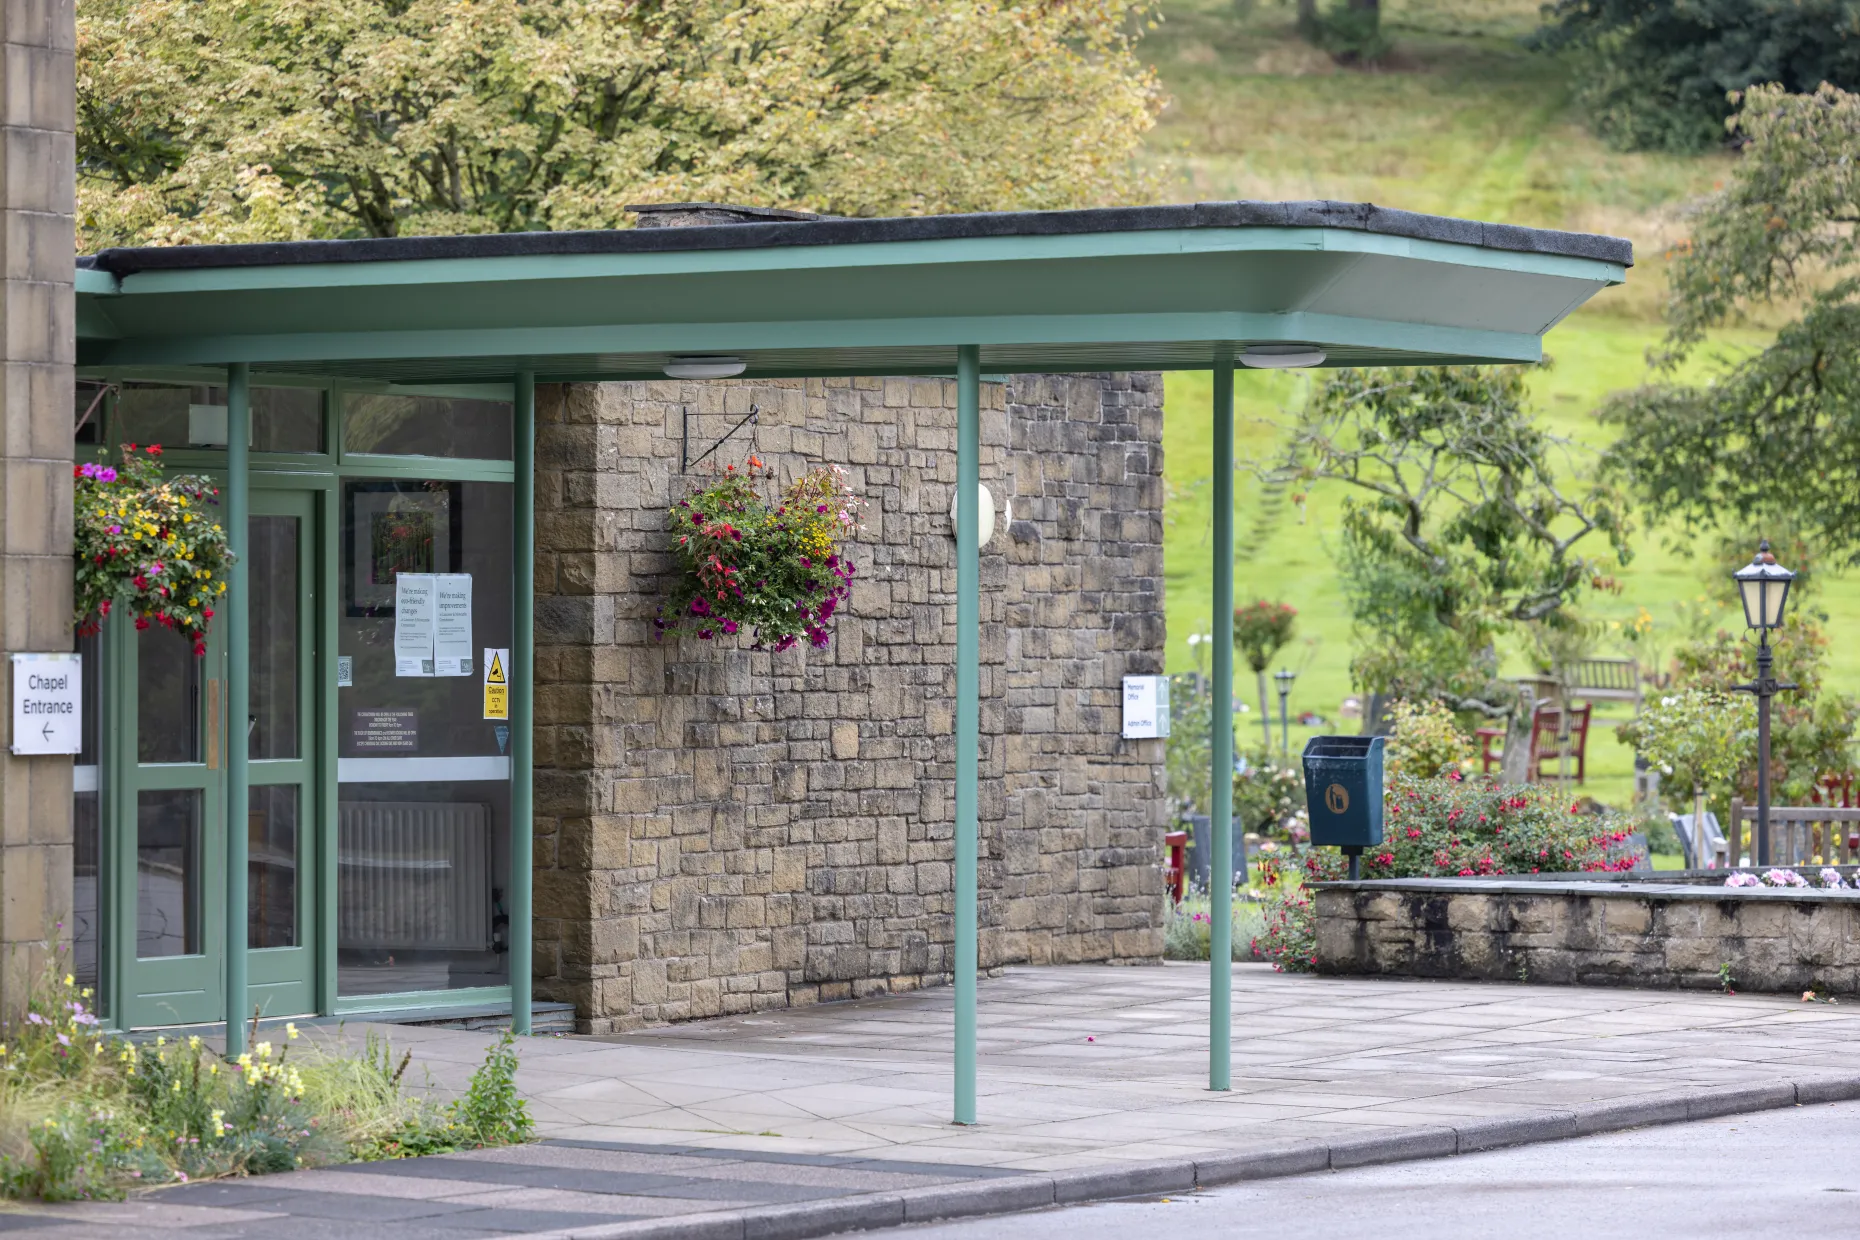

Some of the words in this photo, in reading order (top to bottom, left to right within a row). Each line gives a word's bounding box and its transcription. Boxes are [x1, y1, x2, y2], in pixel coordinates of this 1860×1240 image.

[401, 587, 413, 595] We're
[414, 588, 428, 596] making
[452, 592, 466, 600] making
[439, 603, 467, 611] improvements
[401, 608, 418, 616] changes
[28, 674, 68, 692] Chapel
[488, 686, 504, 694] Caution
[23, 698, 73, 714] Entrance
